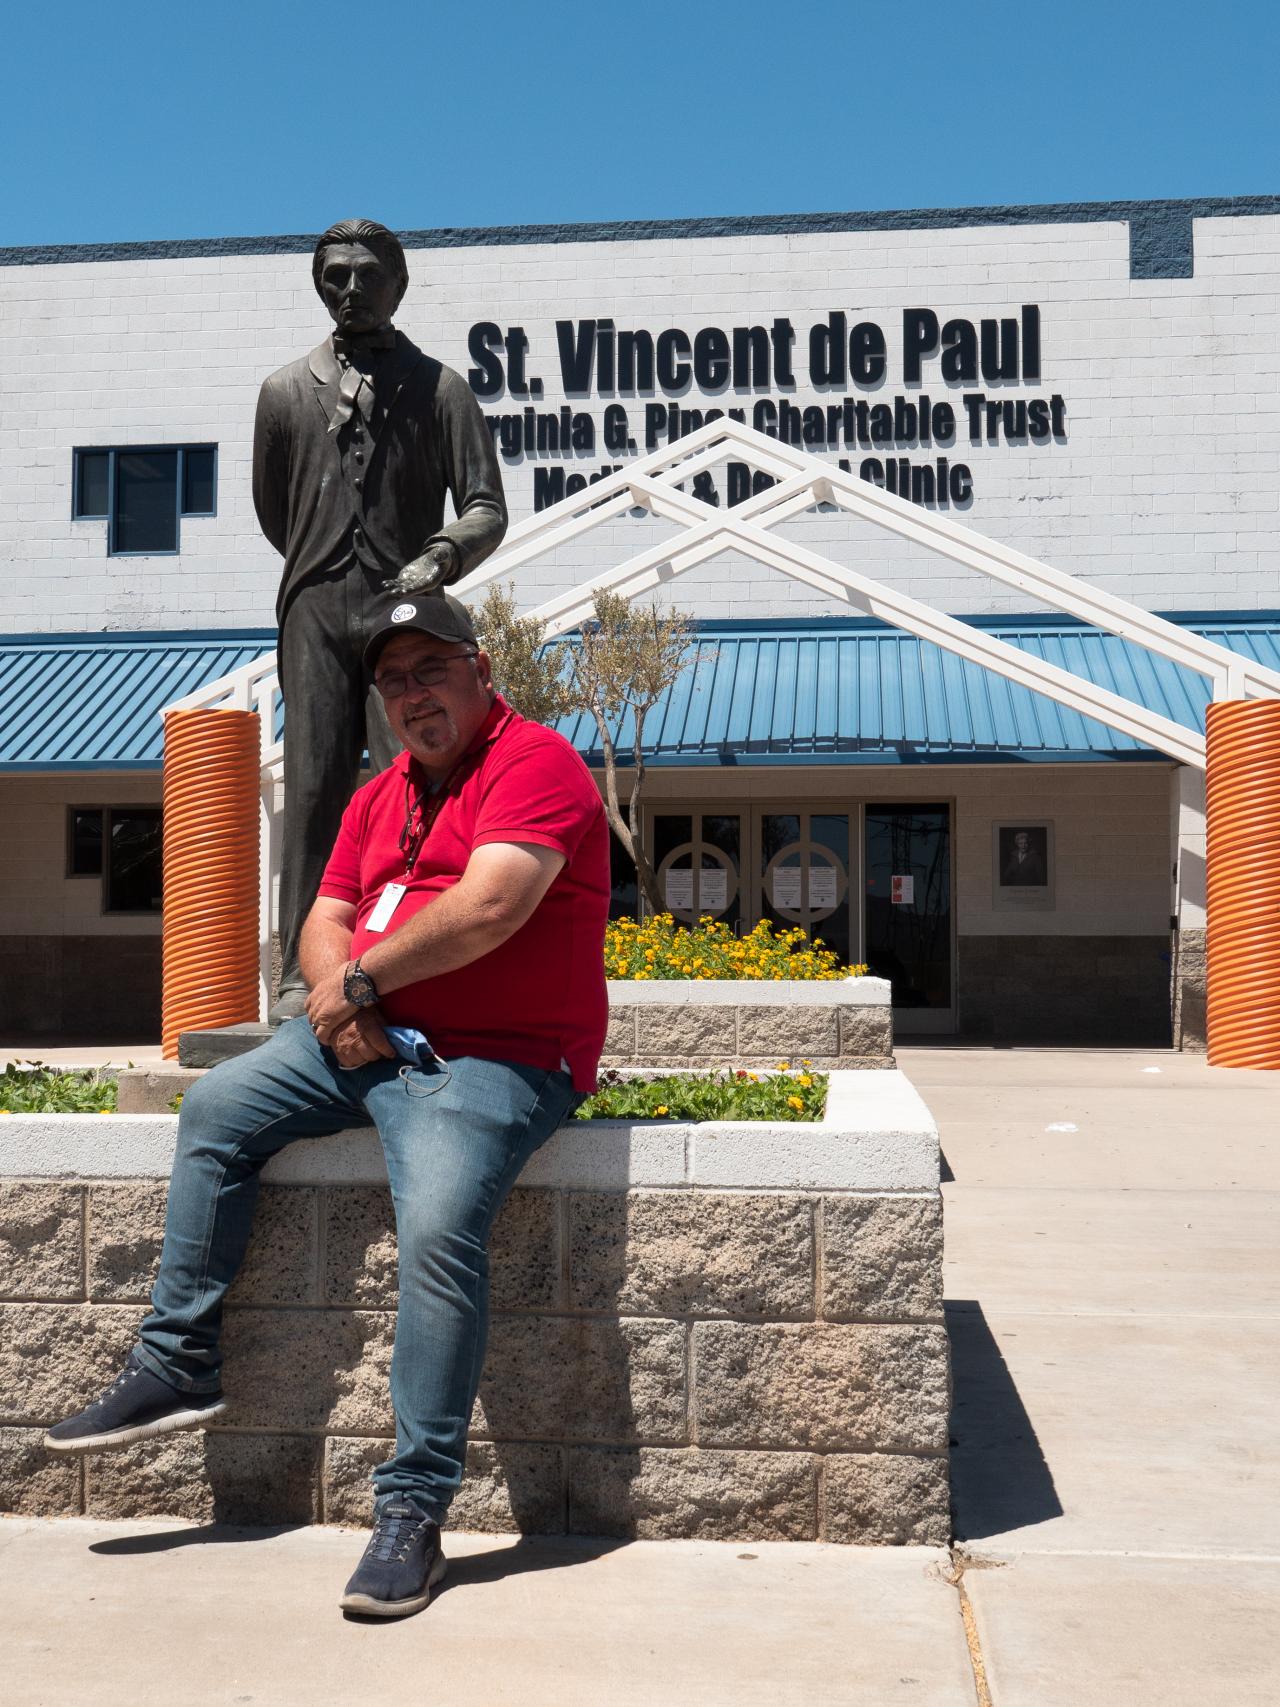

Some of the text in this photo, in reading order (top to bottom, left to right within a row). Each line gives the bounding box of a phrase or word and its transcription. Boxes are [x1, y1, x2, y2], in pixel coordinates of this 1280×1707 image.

[468, 304, 1040, 396] St. Vincent de Paul
[484, 405, 595, 458] rginia
[603, 403, 637, 451] G.
[753, 394, 956, 445] Charitable
[962, 393, 1067, 440] Trust
